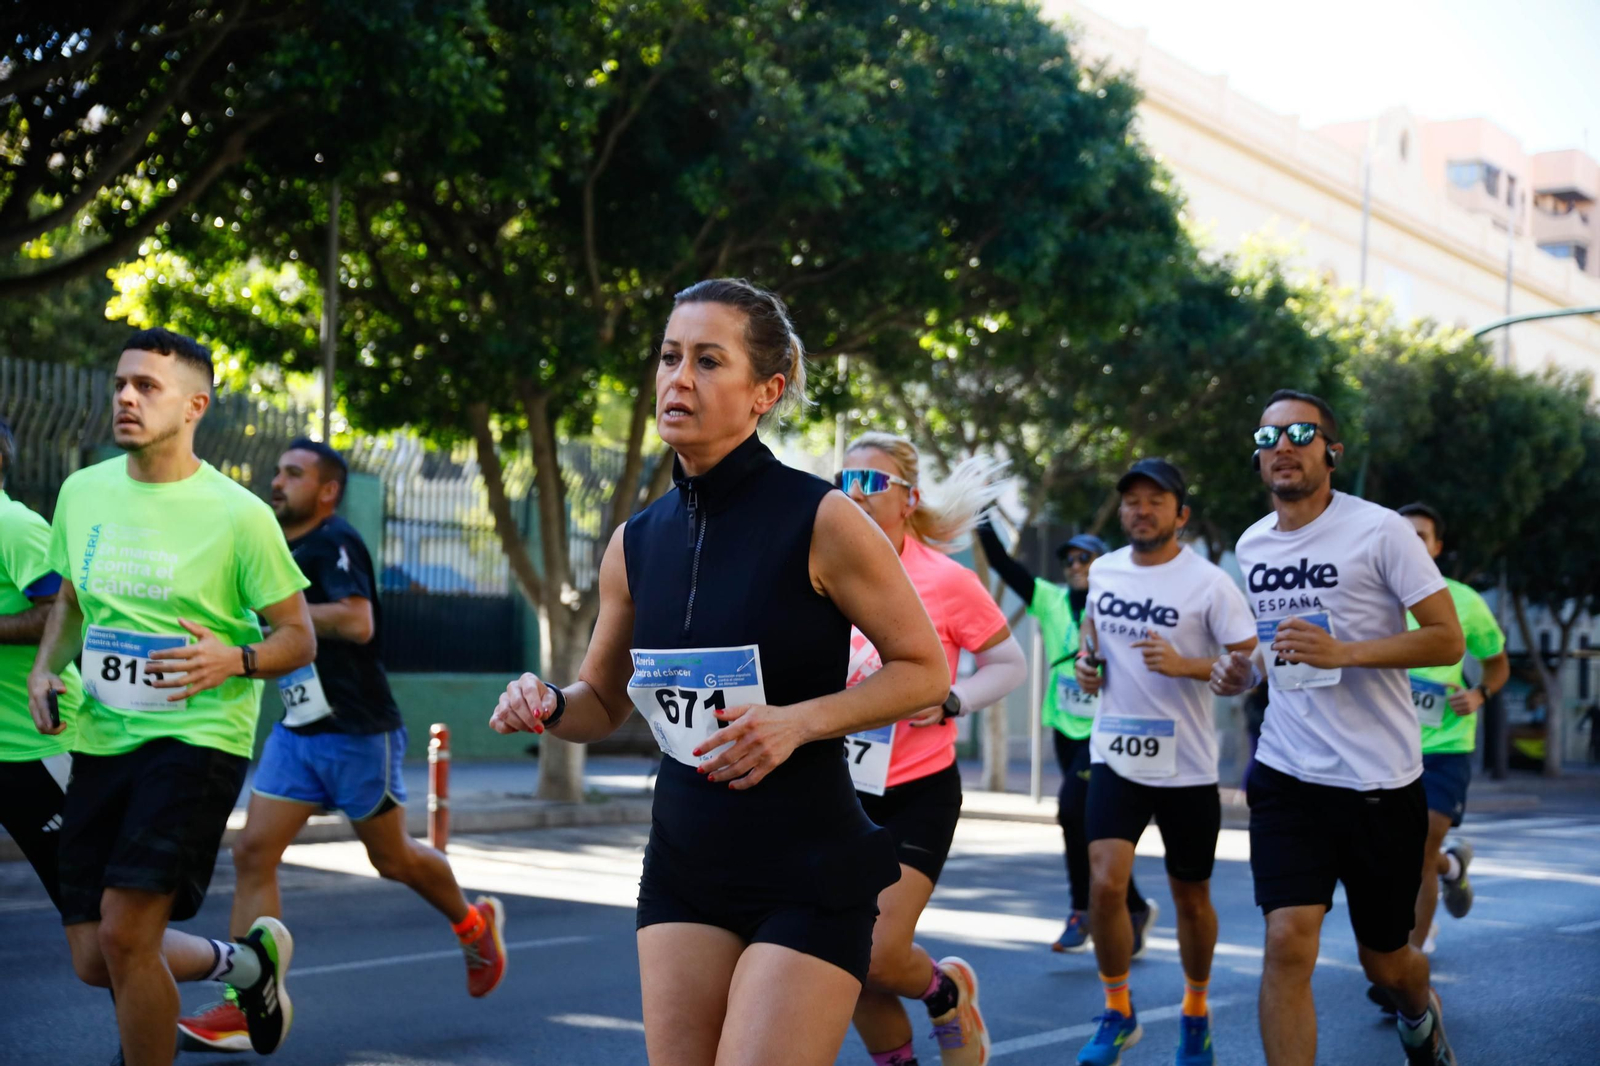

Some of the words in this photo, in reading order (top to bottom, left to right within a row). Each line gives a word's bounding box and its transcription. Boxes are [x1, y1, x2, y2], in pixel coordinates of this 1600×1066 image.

[79, 523, 102, 592] ALMERÍA
[119, 546, 178, 564] marcha
[94, 559, 151, 577] contra
[155, 565, 175, 581] el
[1249, 558, 1338, 593] Cooke
[91, 574, 173, 601] cáncer
[1097, 592, 1179, 627] Cooke
[1258, 593, 1323, 612] ESPAÑA
[1101, 621, 1158, 639] ESPAÑ
[652, 668, 662, 678] el
[655, 688, 729, 729] 671
[1108, 734, 1159, 758] 409
